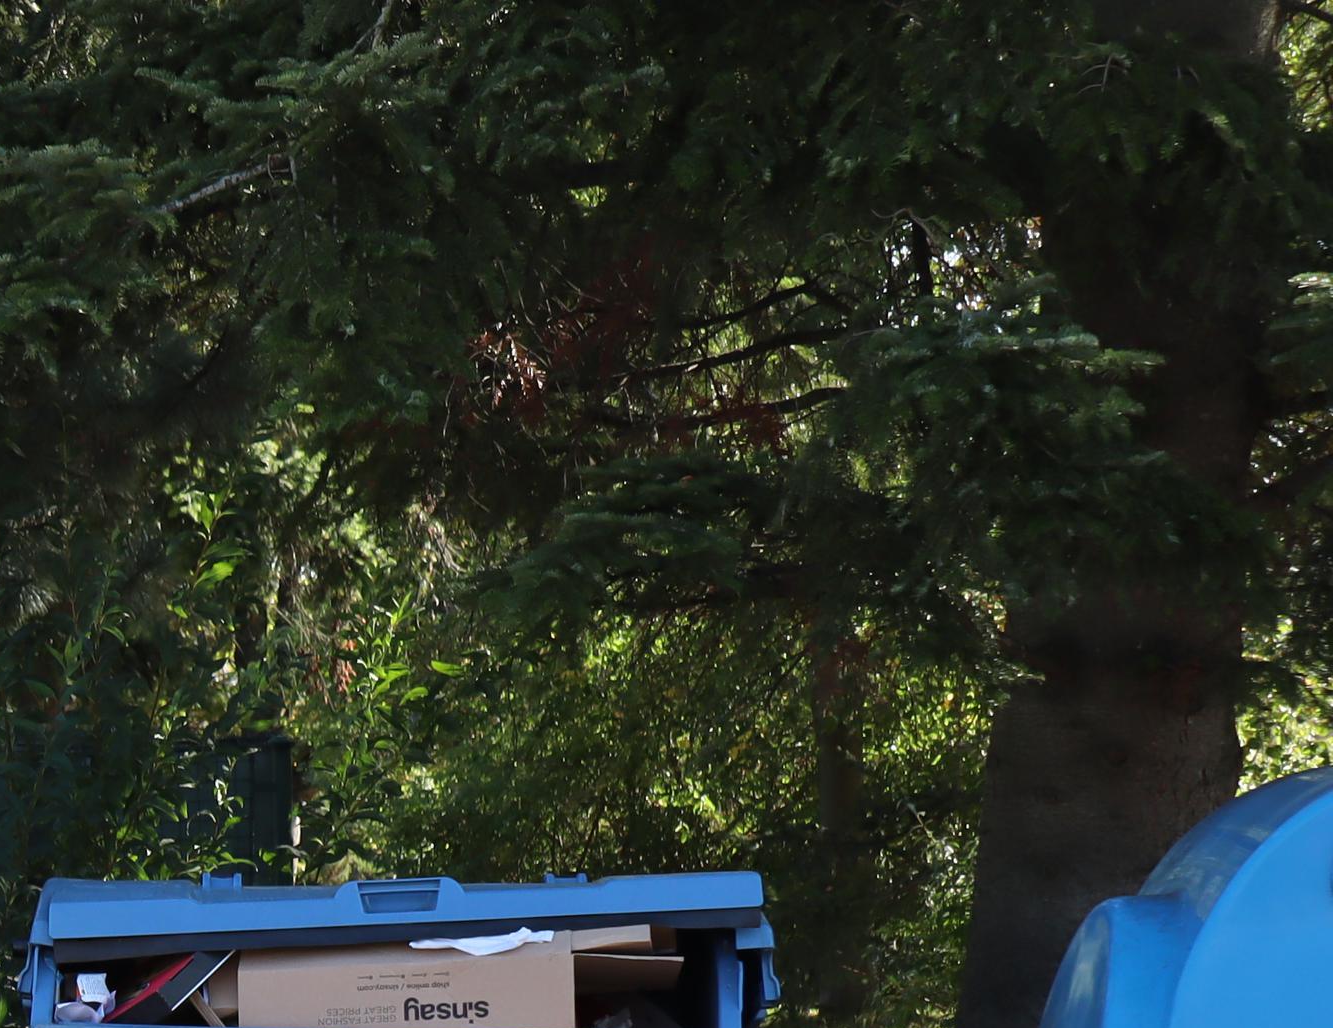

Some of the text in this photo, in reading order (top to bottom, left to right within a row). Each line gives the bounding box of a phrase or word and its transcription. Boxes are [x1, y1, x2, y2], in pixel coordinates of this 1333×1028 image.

[326, 1007, 361, 1017] PRICES
[404, 997, 489, 1024] sinsay
[318, 1016, 359, 1026] FASHION
